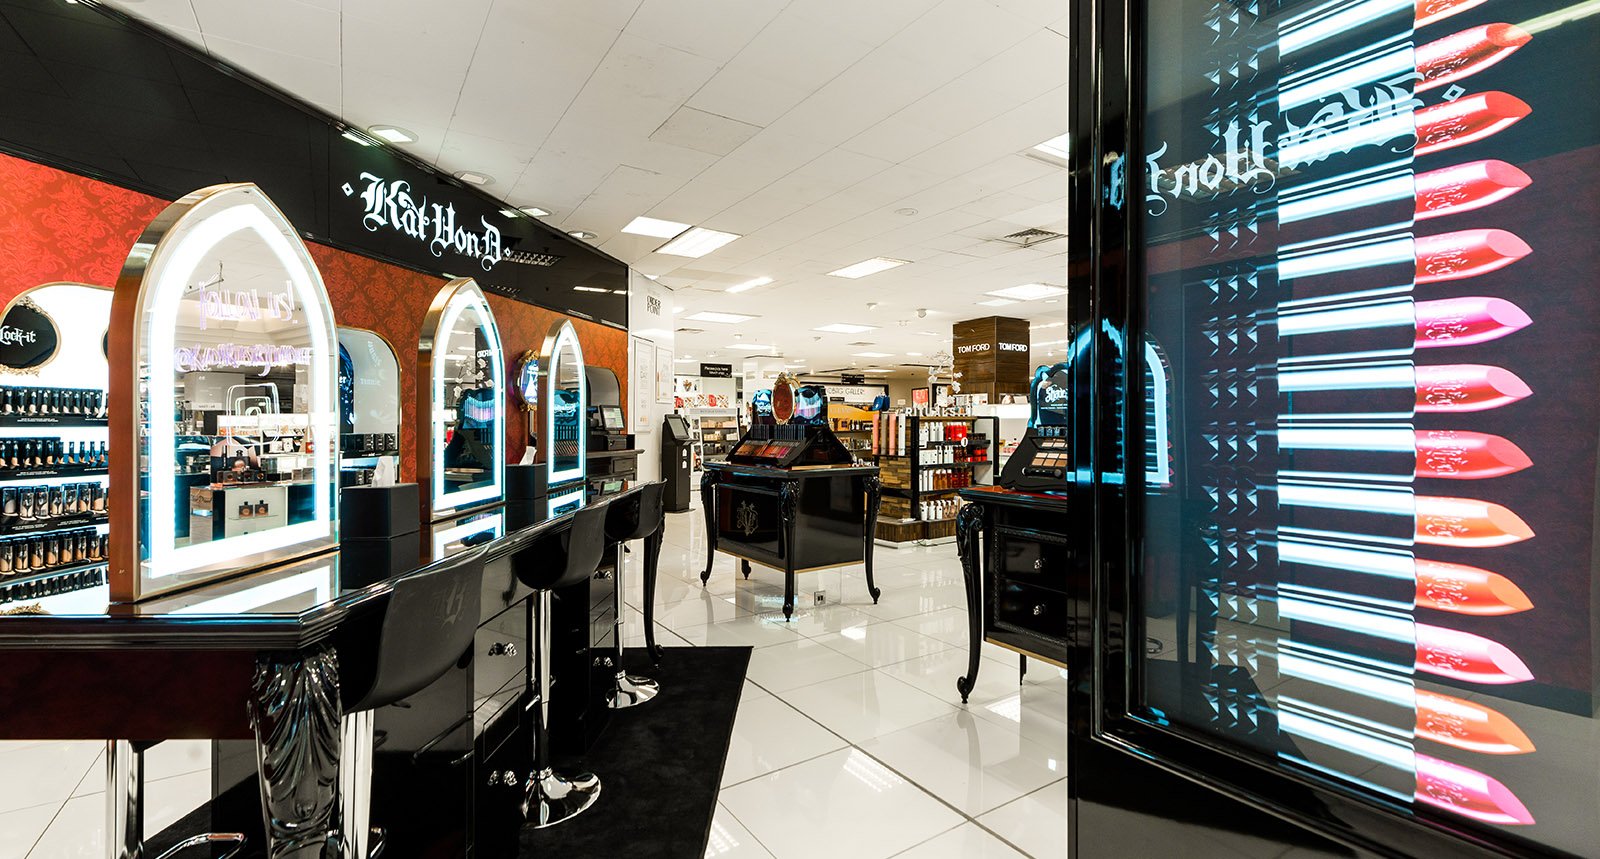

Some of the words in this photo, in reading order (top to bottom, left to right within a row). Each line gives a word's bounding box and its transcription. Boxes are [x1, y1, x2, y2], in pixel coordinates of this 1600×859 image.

[359, 172, 430, 241] Kat
[430, 202, 481, 259] Von
[481, 215, 503, 272] D
[958, 345, 971, 354] TOM
[972, 343, 990, 352] FORD
[998, 342, 1011, 351] TOM
[1012, 343, 1028, 352] FORD
